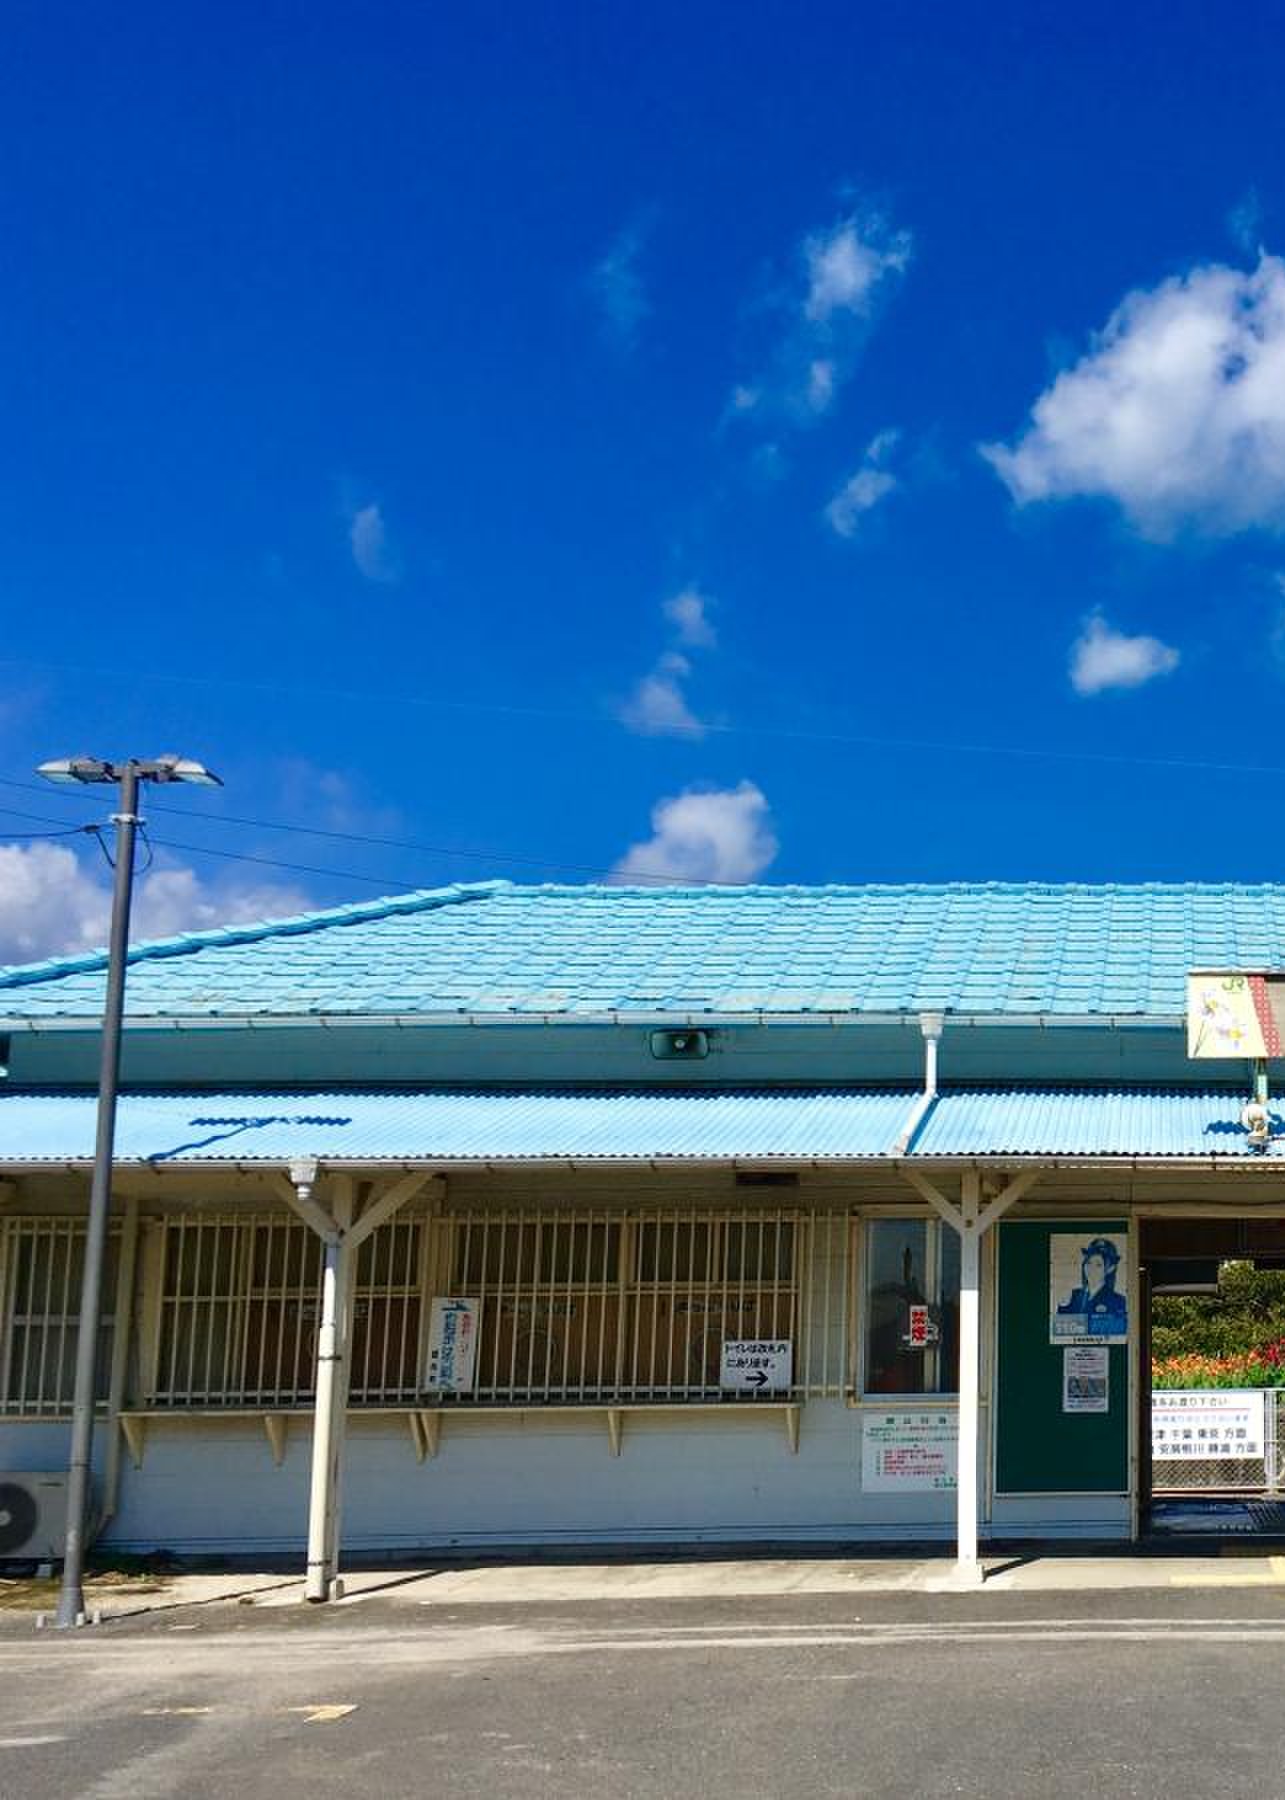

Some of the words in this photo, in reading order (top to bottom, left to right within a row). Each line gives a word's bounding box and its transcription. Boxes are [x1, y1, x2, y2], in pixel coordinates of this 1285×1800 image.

[726, 1357, 776, 1369] にあります。
